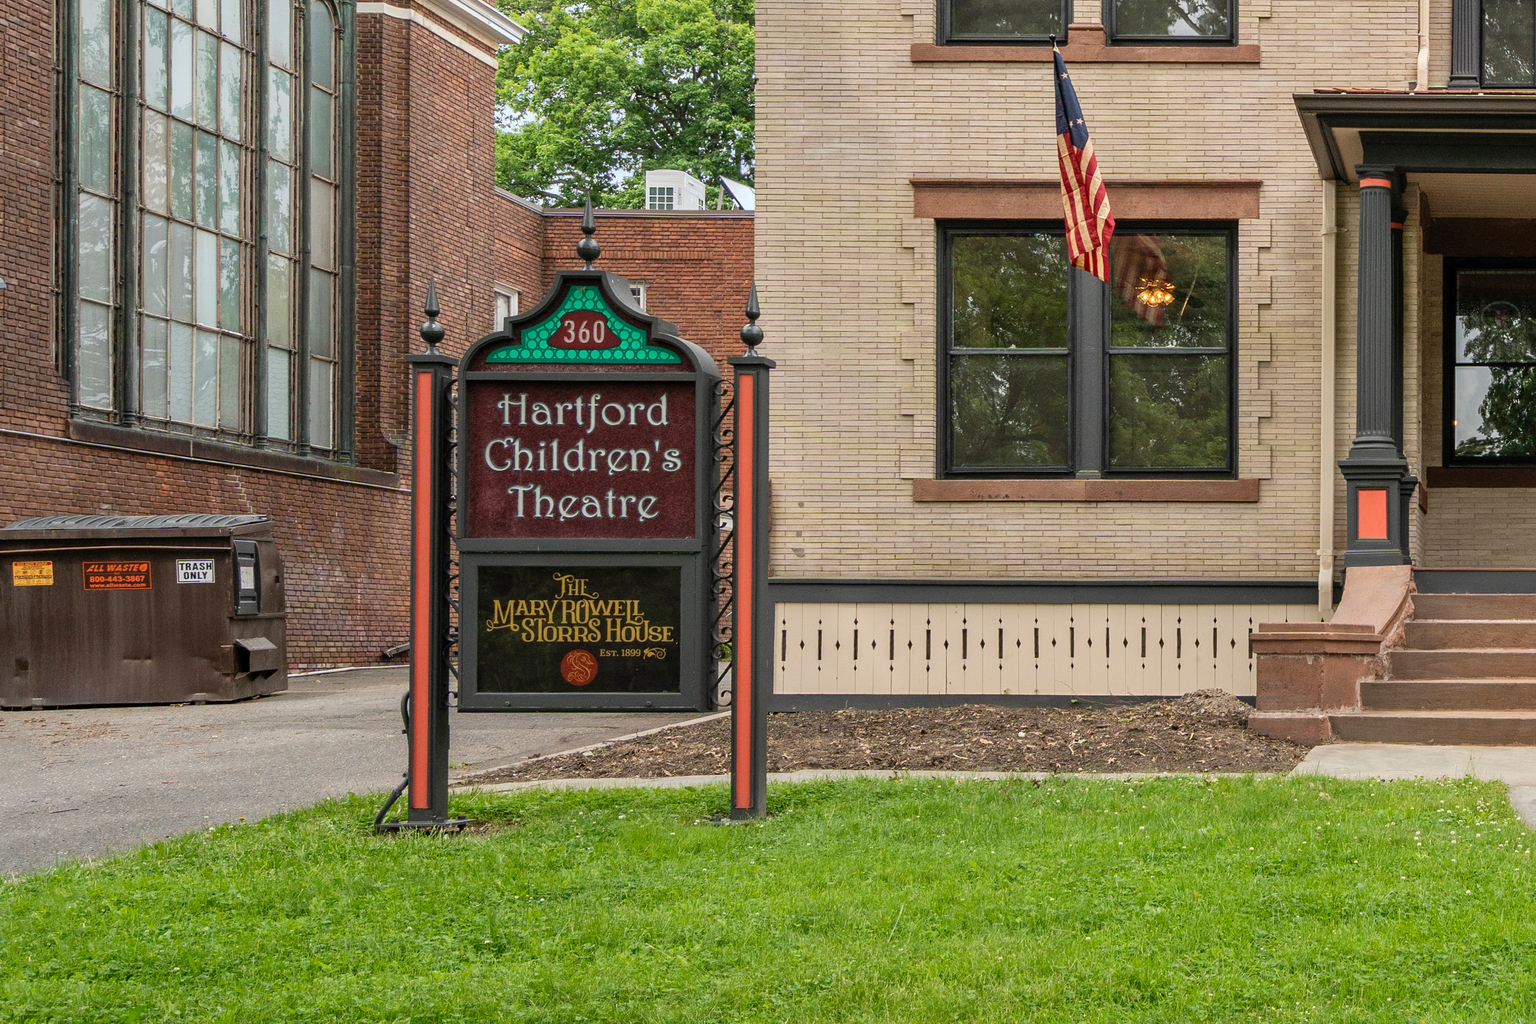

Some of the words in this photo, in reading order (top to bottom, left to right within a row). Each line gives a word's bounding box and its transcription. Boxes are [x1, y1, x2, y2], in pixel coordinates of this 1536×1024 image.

[563, 320, 605, 344] 360
[497, 392, 669, 434] Hartford
[484, 436, 682, 475] Children's
[507, 483, 660, 522] Theatre
[86, 564, 104, 573] ALL
[107, 563, 139, 572] WASTE
[179, 562, 212, 571] TRASH
[89, 575, 145, 583] 800-443-3867
[183, 571, 208, 580] ONLY
[621, 648, 641, 657] 1899
